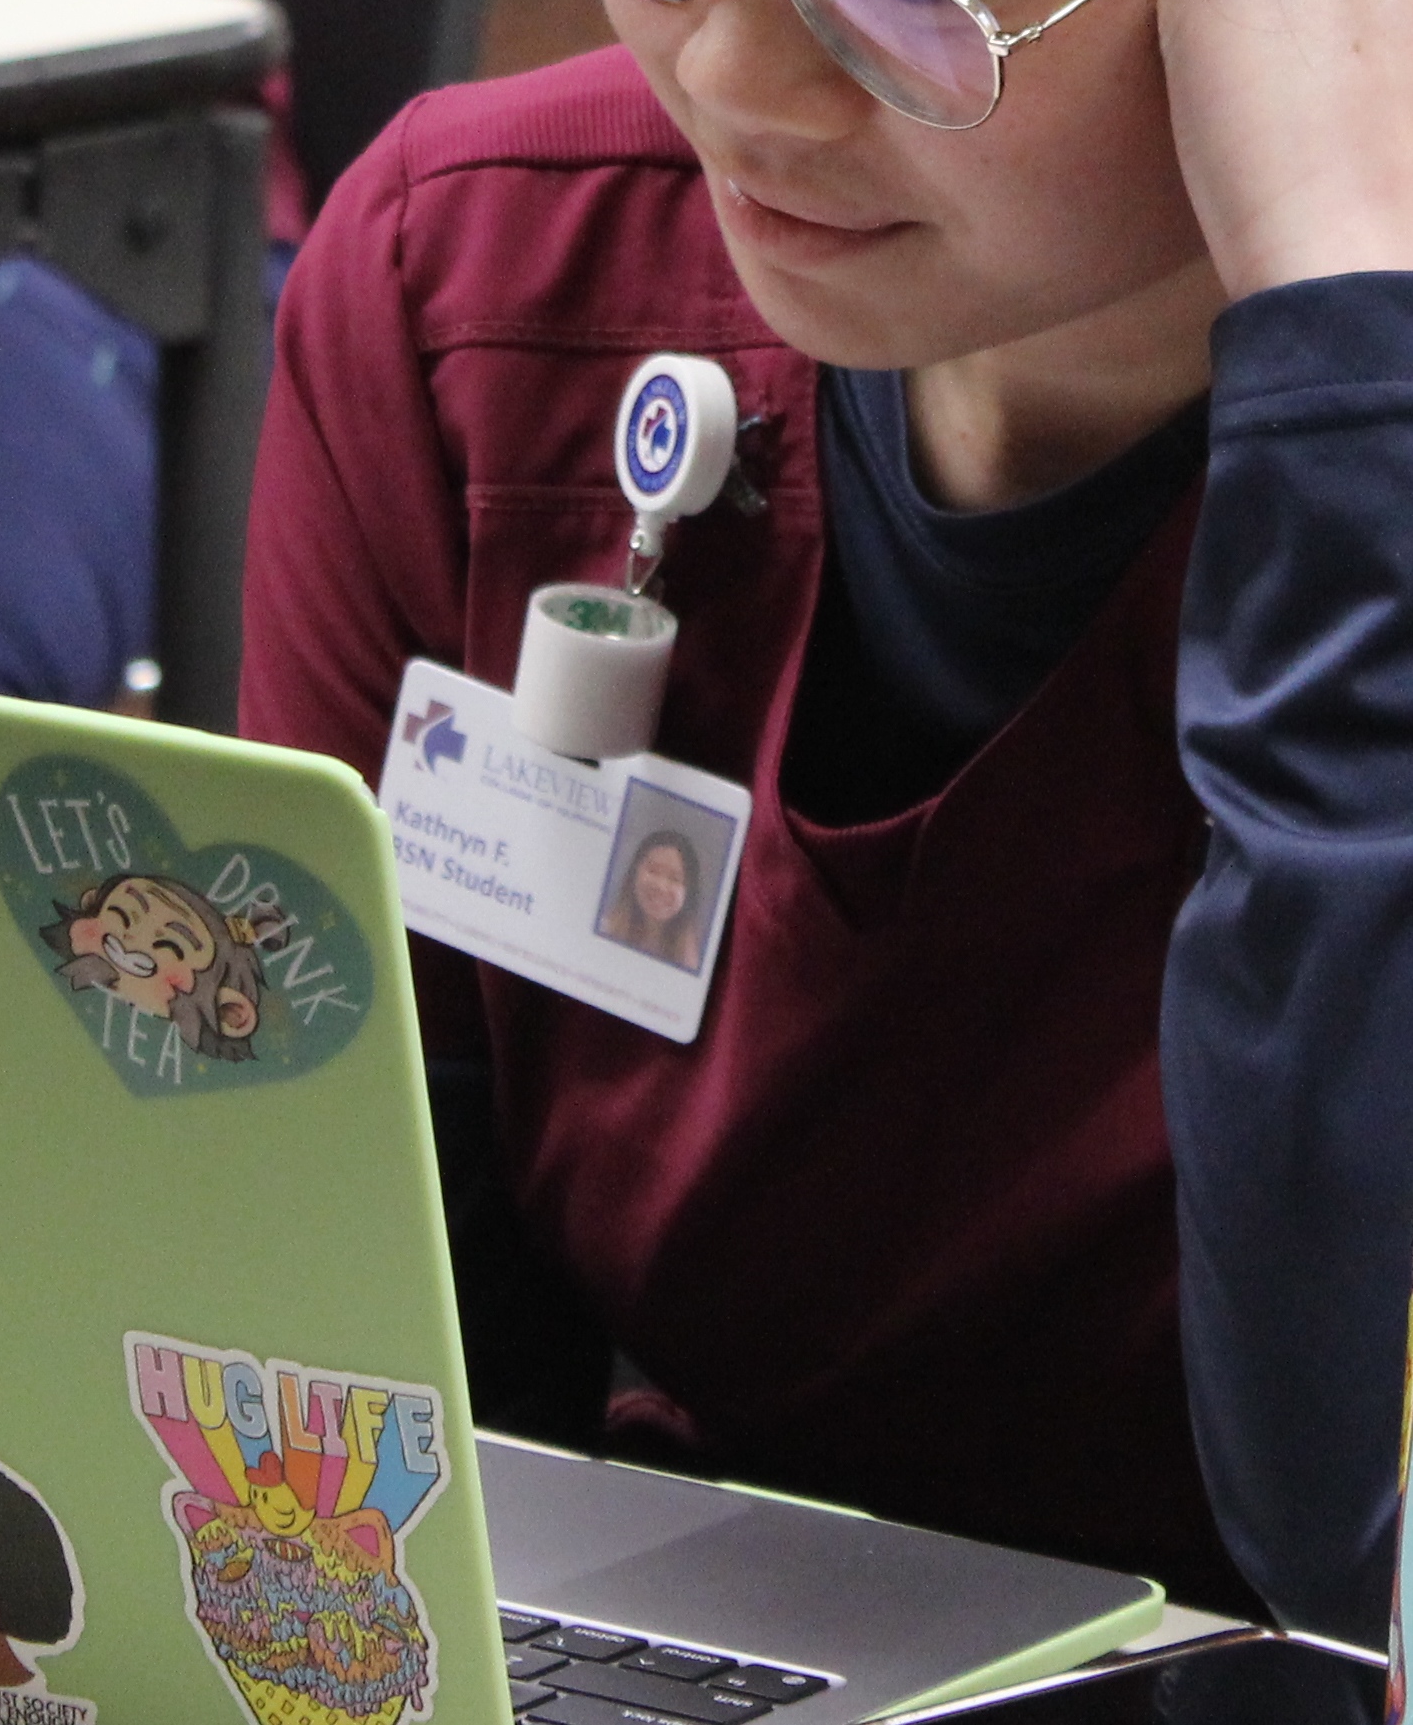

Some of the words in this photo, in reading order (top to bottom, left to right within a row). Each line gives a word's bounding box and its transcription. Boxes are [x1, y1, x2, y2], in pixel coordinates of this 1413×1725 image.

[564, 599, 634, 637] 3M
[482, 744, 610, 816] LAKEVIEW
[6, 789, 132, 874] LET'S
[394, 799, 487, 856] Kathryn
[493, 841, 511, 867] F.
[441, 857, 535, 915] Student
[205, 853, 360, 1024] DRINK
[90, 980, 184, 1085] TEA
[133, 1343, 270, 1440] HUG
[276, 1371, 442, 1475] LIFE
[660, 1647, 721, 1664] control
[22, 1695, 88, 1721] SOCIETY
